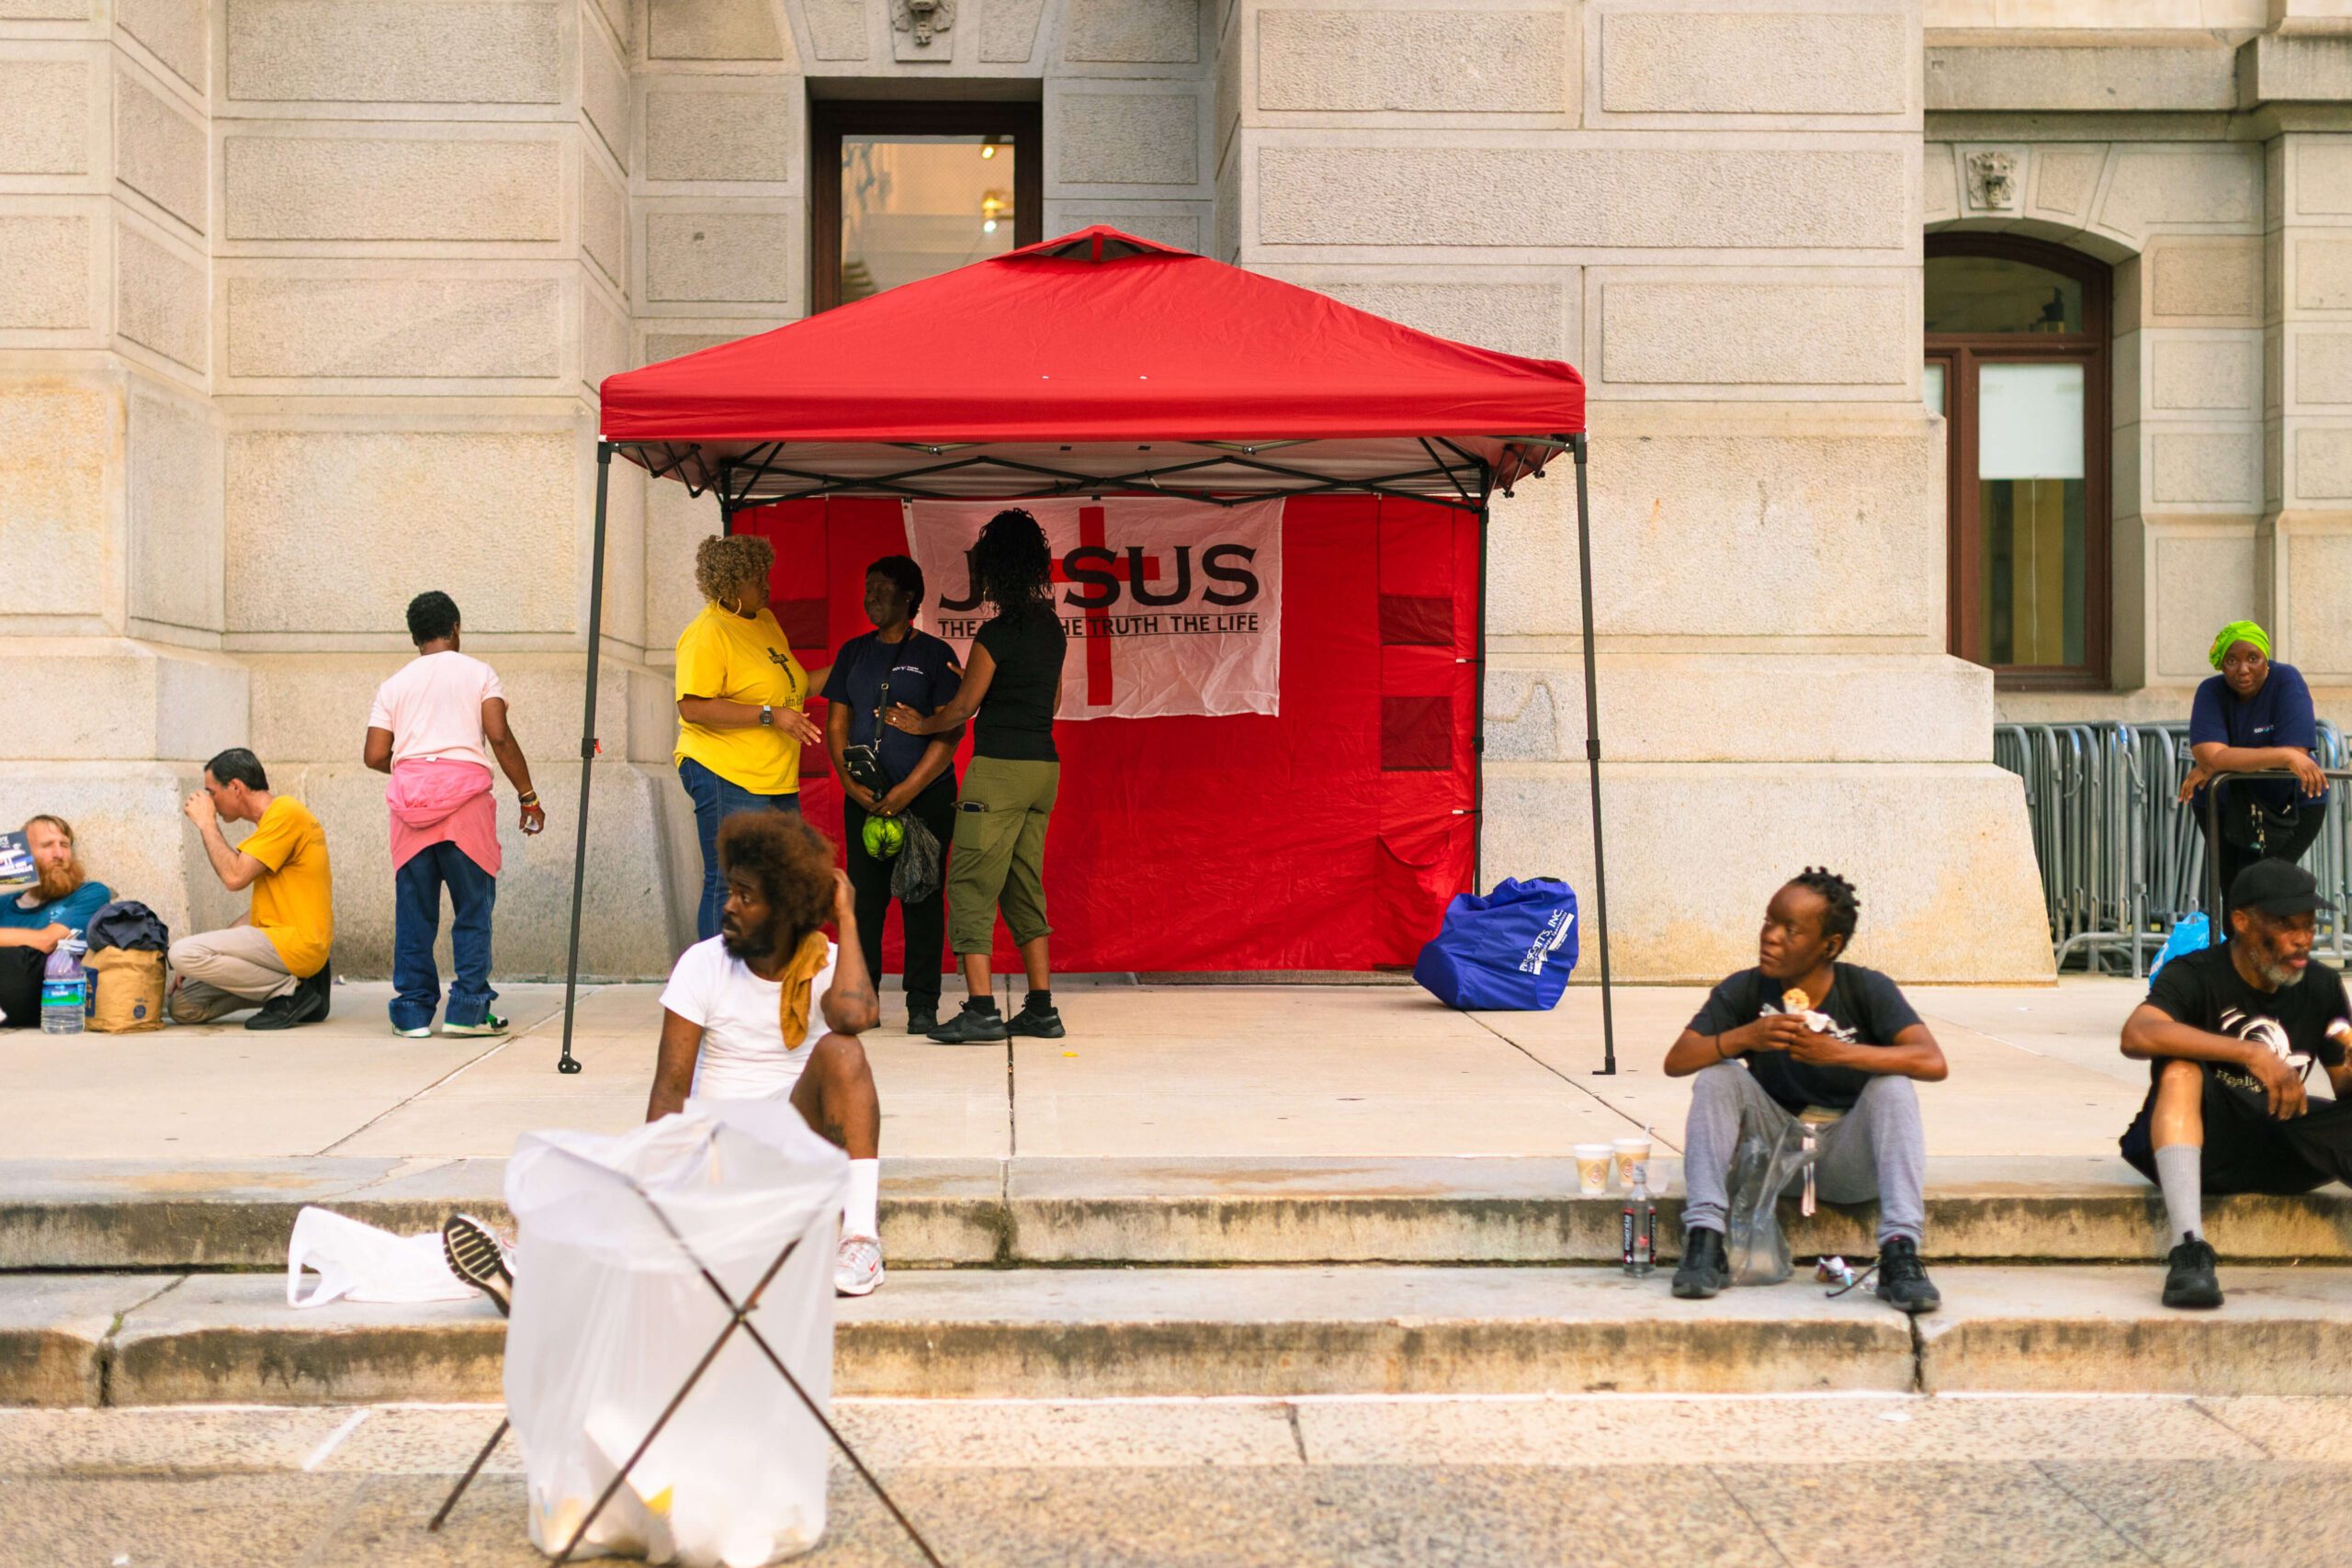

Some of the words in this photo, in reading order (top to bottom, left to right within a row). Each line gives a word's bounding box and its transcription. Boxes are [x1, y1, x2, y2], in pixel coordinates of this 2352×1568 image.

[939, 544, 1260, 612] JSUS
[938, 621, 977, 637] THE
[1063, 619, 1082, 636] HE
[1089, 616, 1158, 636] TRUTH
[1170, 615, 1209, 632] THE
[1217, 615, 1259, 631] LIFE
